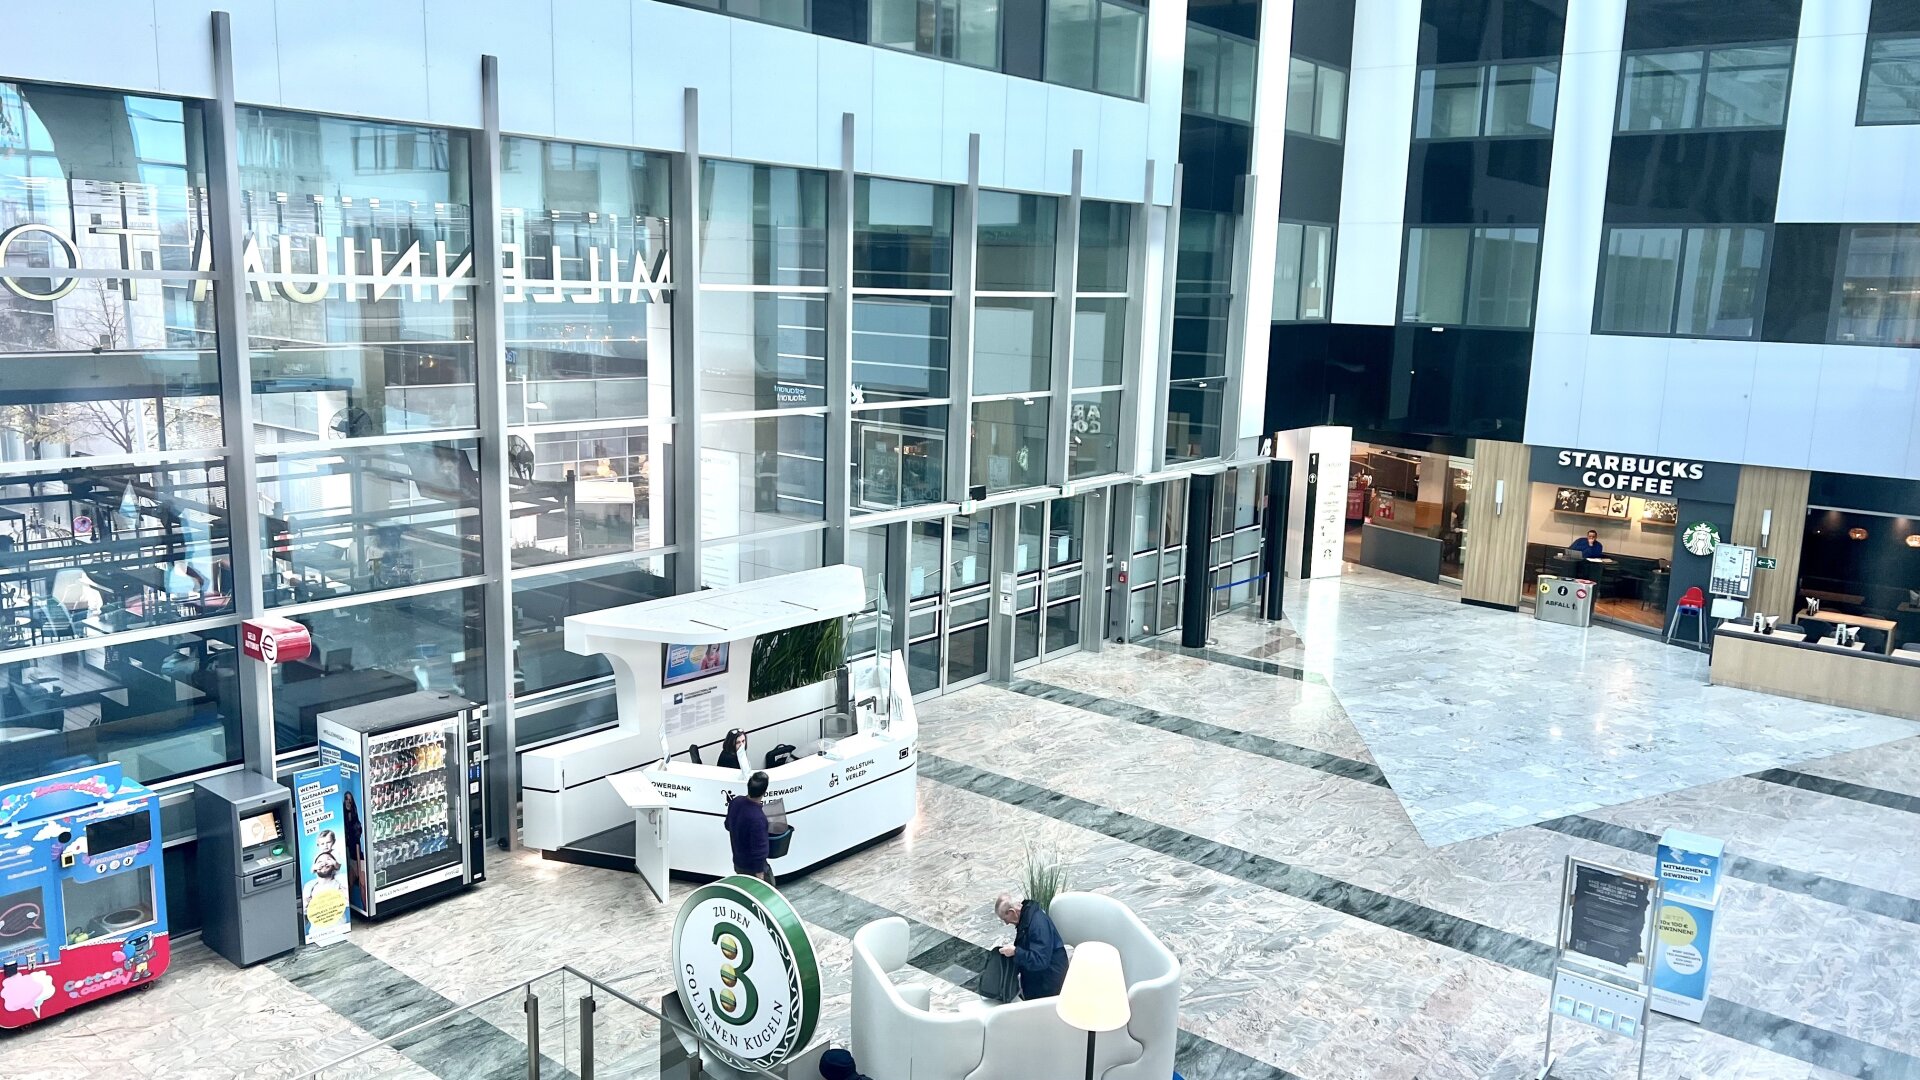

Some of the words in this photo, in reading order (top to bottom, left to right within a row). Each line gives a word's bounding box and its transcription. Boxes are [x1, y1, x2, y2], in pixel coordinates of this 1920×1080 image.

[1311, 454, 1316, 465] 1
[1558, 450, 1704, 480] STARBUCKS
[1582, 471, 1674, 495] COFFEE
[1545, 600, 1571, 609] ABFALL
[845, 758, 875, 773] ROLLSTUHL
[845, 769, 867, 782] VERLEIH
[300, 783, 319, 793] WENN
[651, 781, 692, 792] OWERBANK
[763, 784, 803, 798] DERWAGEN
[658, 790, 677, 799] LEIH
[303, 799, 322, 809] WEISE
[304, 808, 323, 818] ALLES
[305, 813, 332, 826] ERLAUBT
[306, 826, 317, 834] IST
[1663, 863, 1704, 874] MITMACHEN
[1663, 871, 1699, 882] GEWINNEN
[712, 905, 726, 918] ZU
[730, 908, 750, 929] DEN
[1656, 925, 1694, 936] EWINNEN!
[709, 921, 759, 1027] 3
[685, 963, 738, 1048] GOLDENEN
[743, 999, 784, 1051] KUGELN
